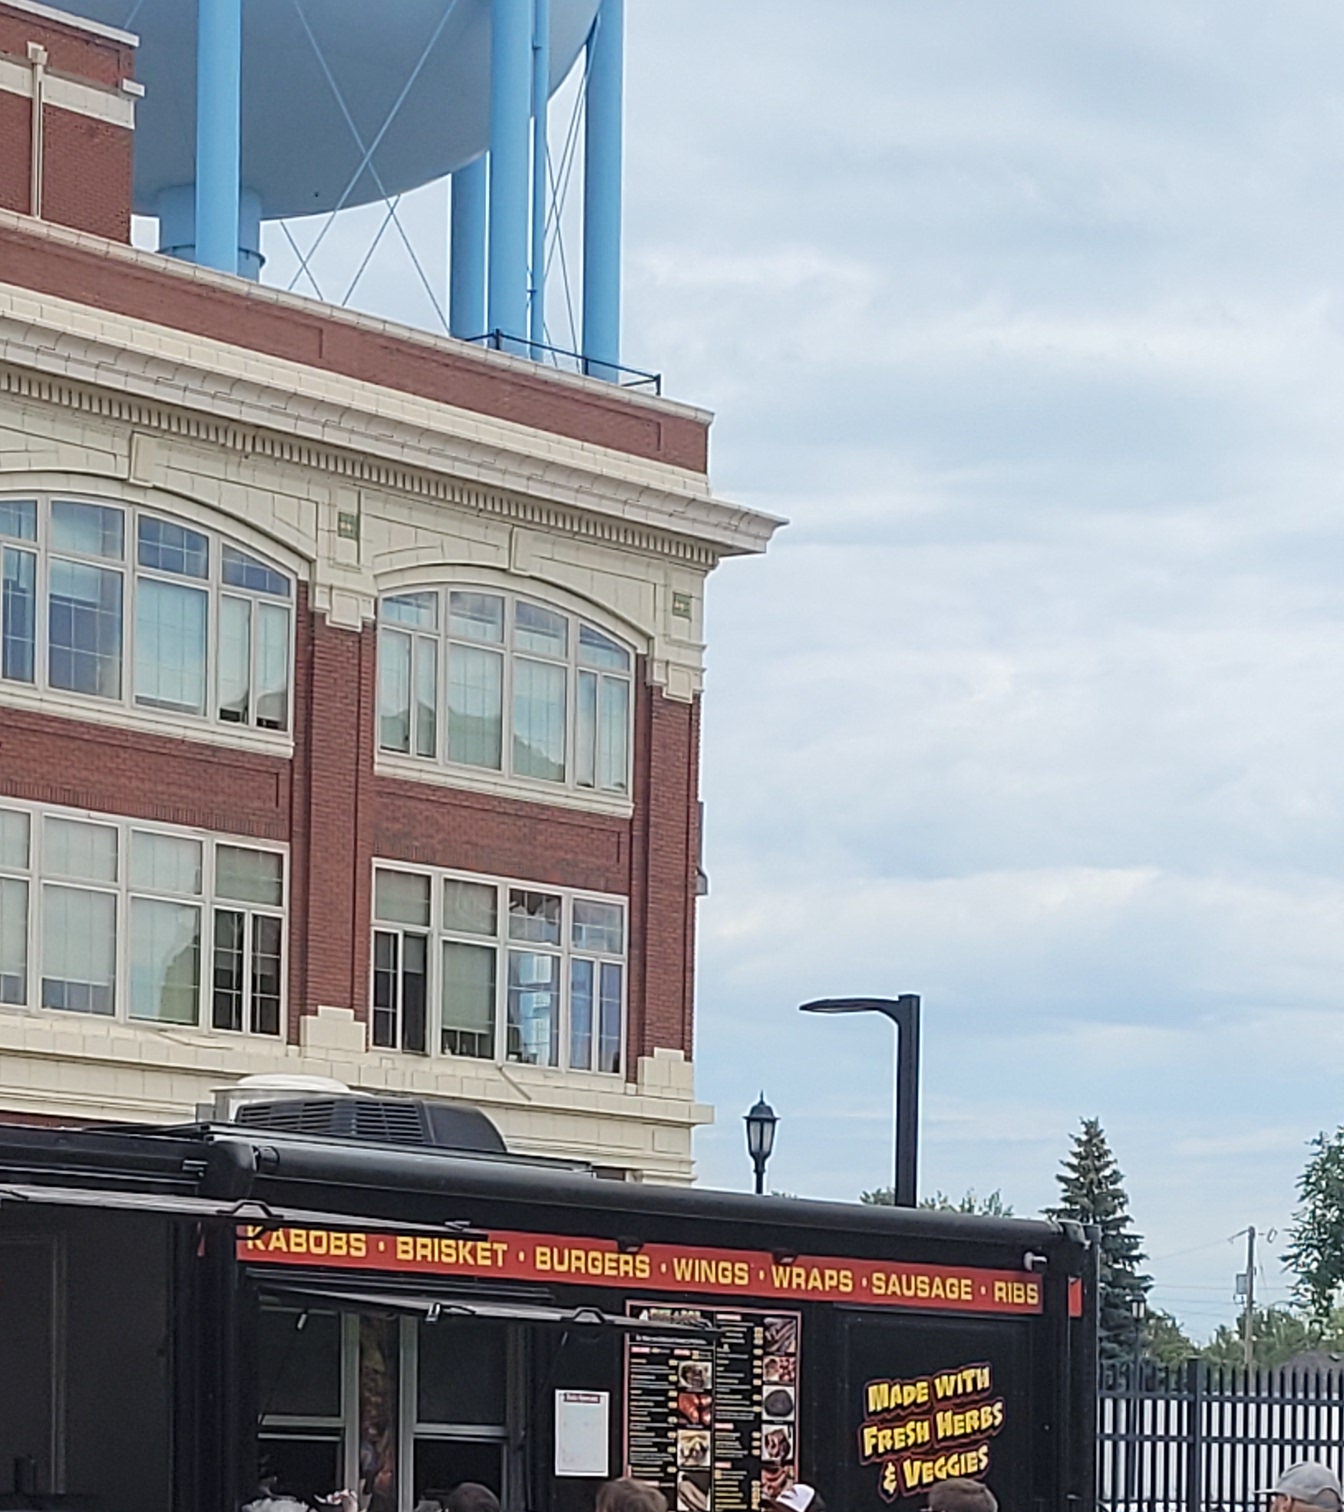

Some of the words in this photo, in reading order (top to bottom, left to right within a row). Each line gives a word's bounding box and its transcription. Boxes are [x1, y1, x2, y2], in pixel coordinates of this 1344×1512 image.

[246, 1225, 366, 1257] KABOBS
[397, 1237, 507, 1267] BRISKET
[536, 1246, 650, 1278] BURGERS
[673, 1258, 749, 1285] WINGS
[772, 1266, 853, 1292] WRAPS
[872, 1273, 972, 1300] SAUSAGE
[994, 1281, 1038, 1304] RIBS
[883, 1462, 897, 1494] &
